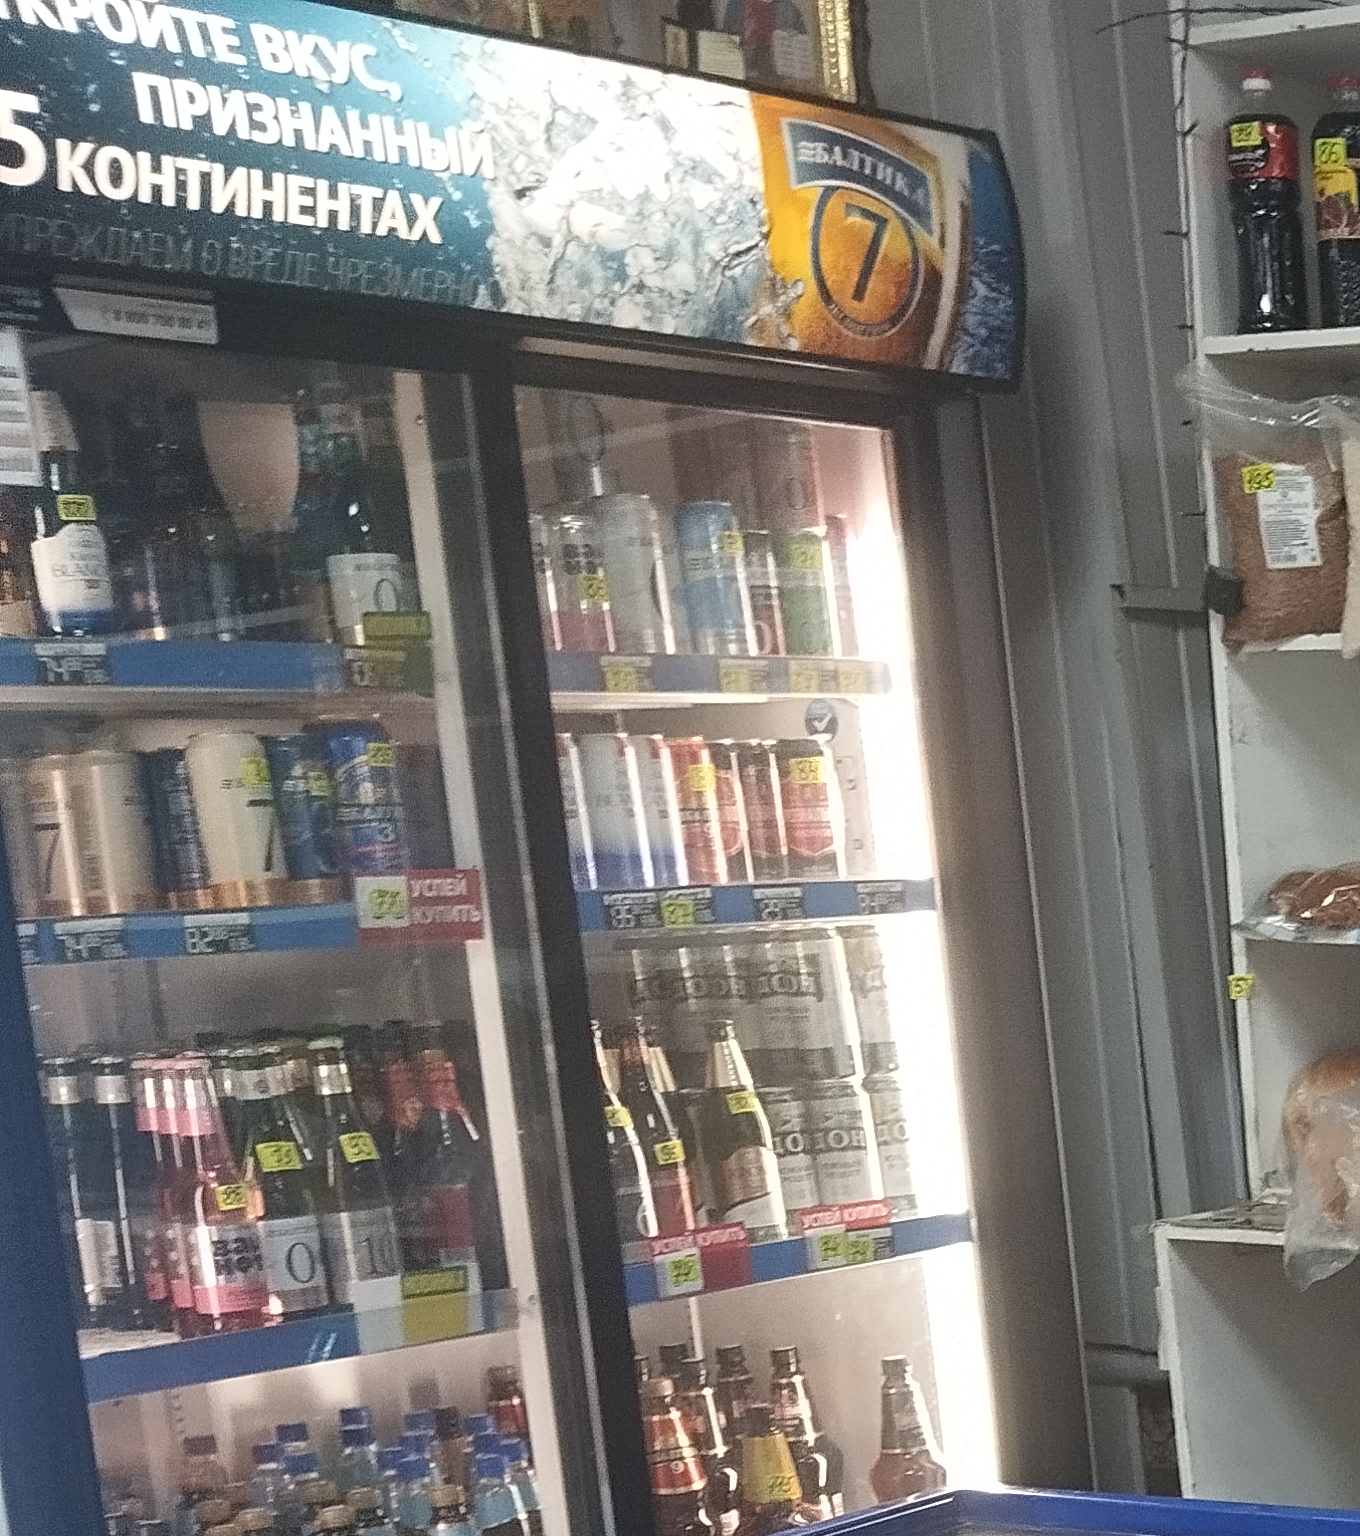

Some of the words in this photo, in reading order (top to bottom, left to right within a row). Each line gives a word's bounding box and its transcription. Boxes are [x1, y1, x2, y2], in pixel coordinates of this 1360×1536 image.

[249, 22, 402, 102] ВКУС,
[132, 72, 497, 180] ПРИЗНАННЫЙ
[55, 137, 443, 244] КОНТИНЕНТАХ
[844, 203, 889, 301] 7
[410, 878, 468, 899] УСПЕЙ
[410, 904, 482, 925] КУПИТЬ
